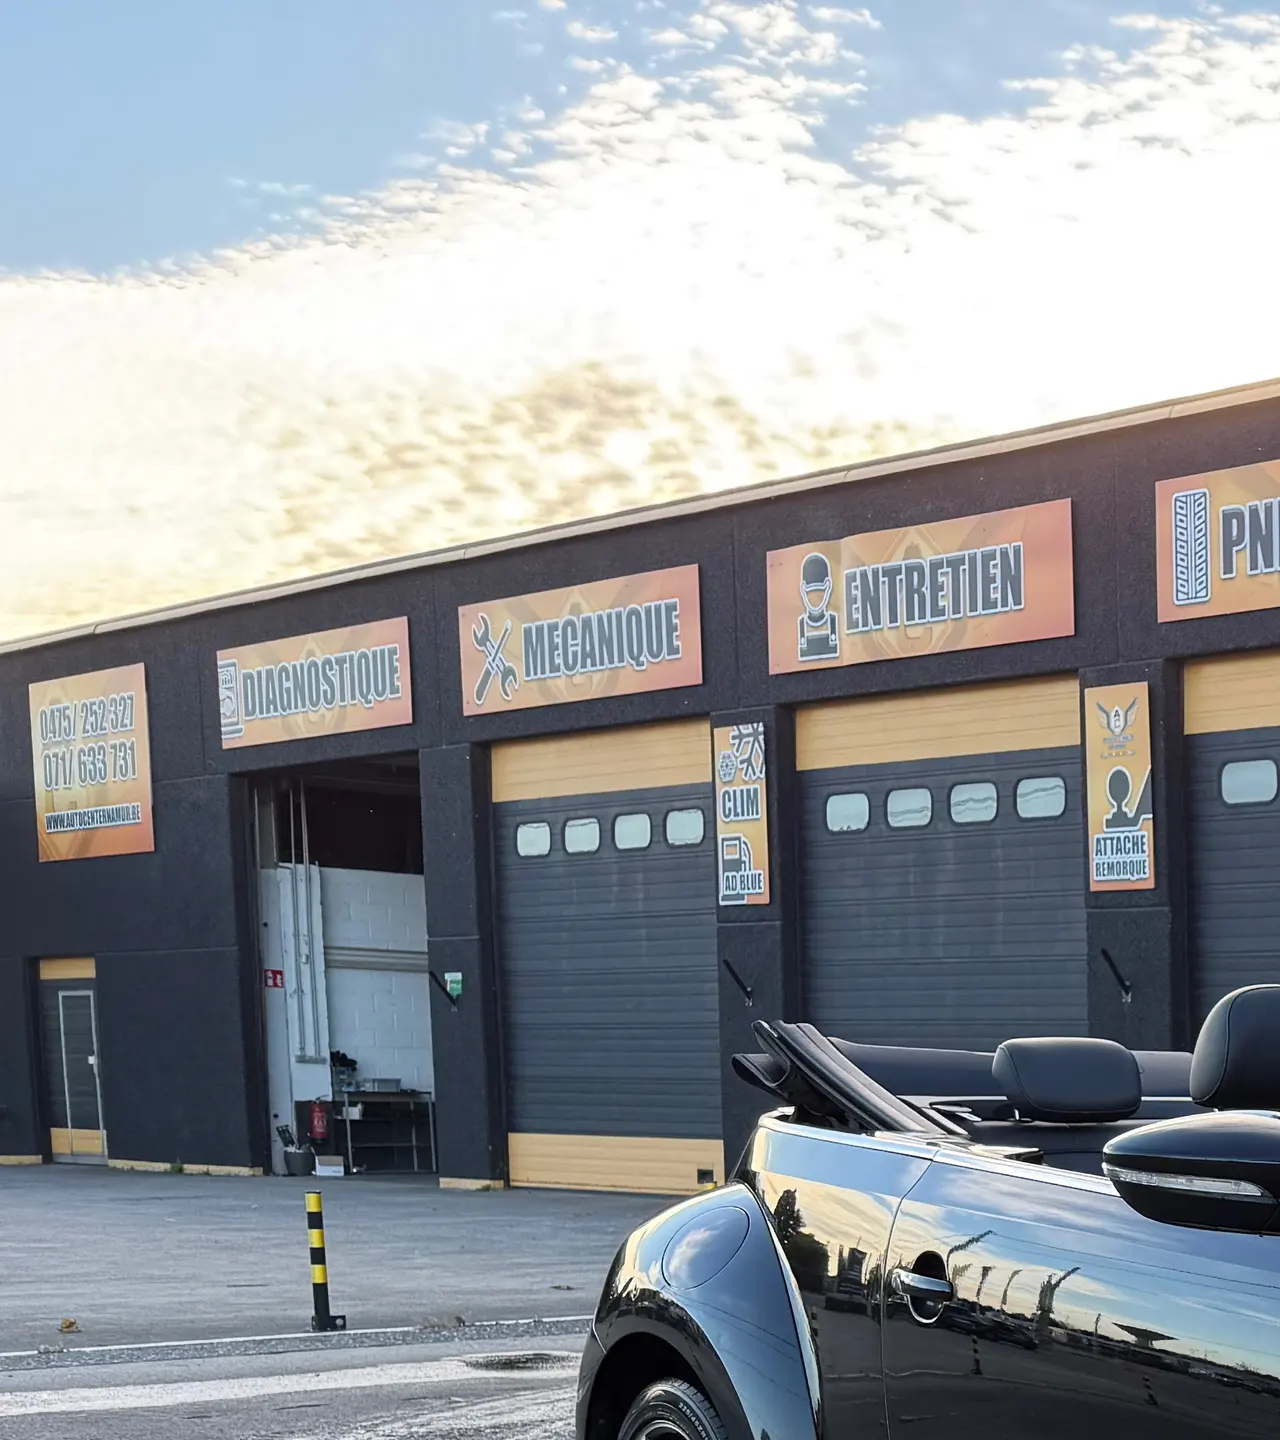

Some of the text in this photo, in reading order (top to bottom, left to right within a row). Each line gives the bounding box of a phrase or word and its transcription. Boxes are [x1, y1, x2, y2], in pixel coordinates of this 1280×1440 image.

[844, 541, 1025, 635] ENTRETIEN
[522, 599, 681, 680] MECANIQUE
[242, 644, 401, 719] DIAGNOSTIQUE
[40, 692, 135, 744] 0475/ 252 327
[43, 738, 138, 791] 071/ 633 731
[45, 803, 141, 832] WWW.AUTOCENTERNAMUR.BE
[721, 786, 761, 821] CLIM
[1094, 834, 1147, 857] ATTACHE
[725, 871, 763, 892] AD BLUE
[1094, 859, 1148, 878] REMORQUE
